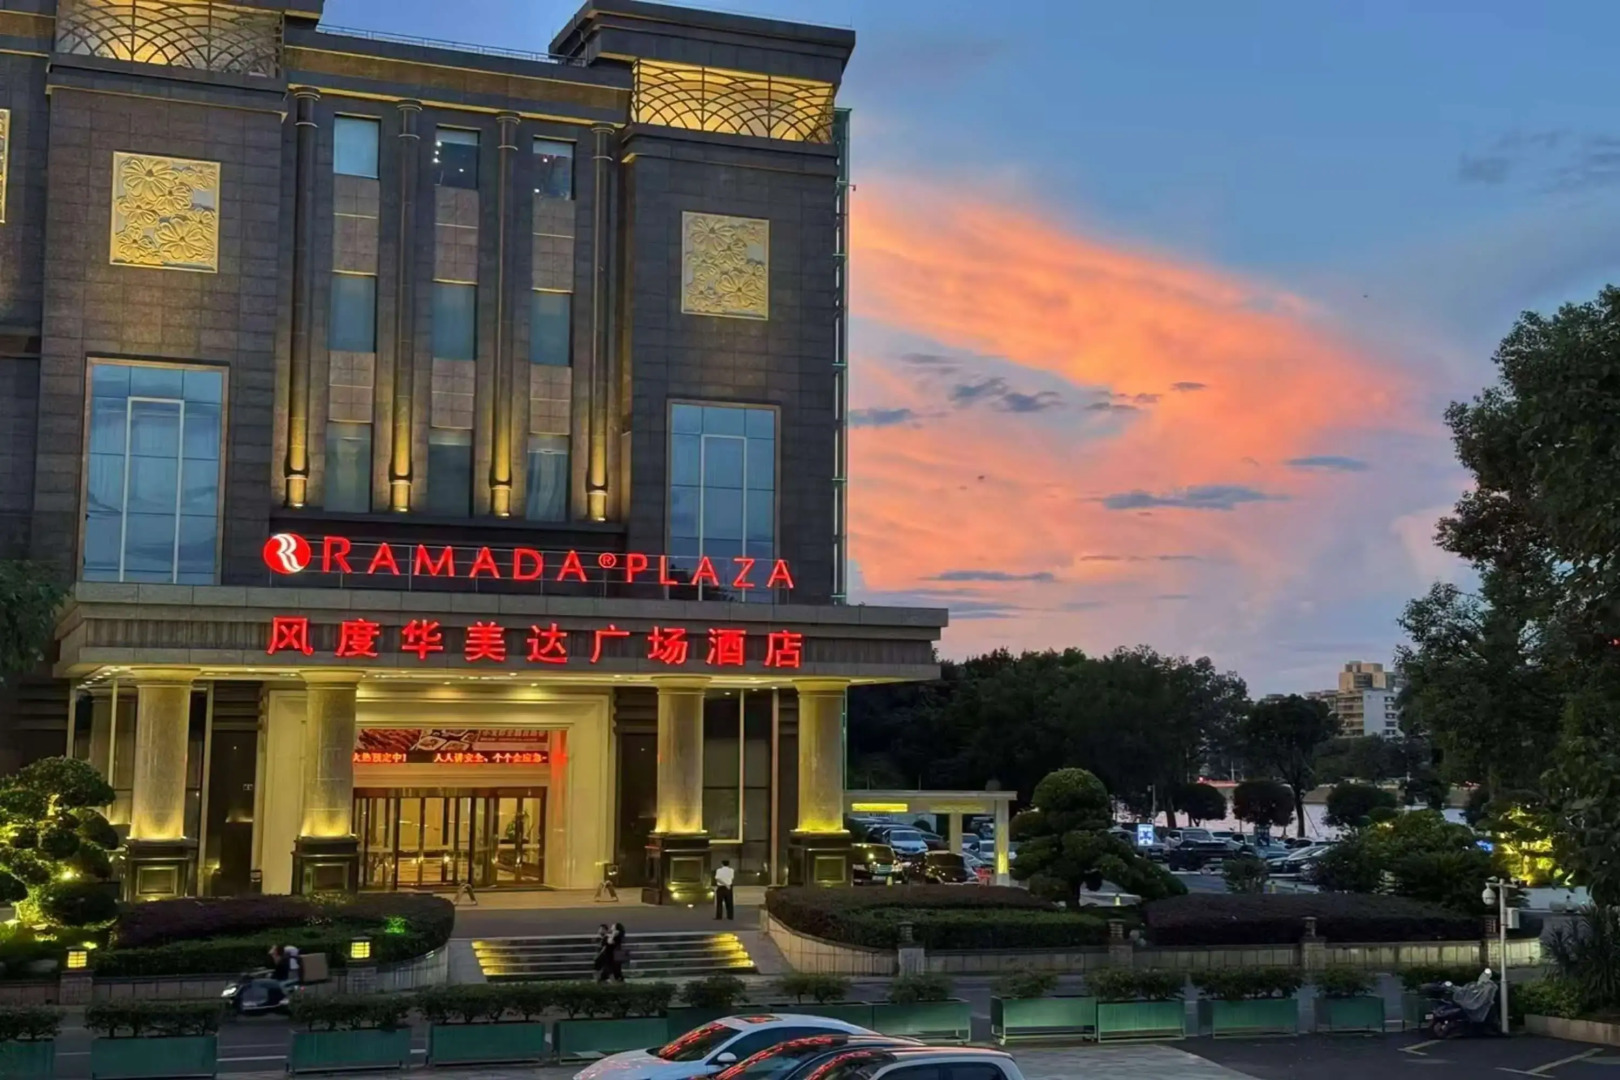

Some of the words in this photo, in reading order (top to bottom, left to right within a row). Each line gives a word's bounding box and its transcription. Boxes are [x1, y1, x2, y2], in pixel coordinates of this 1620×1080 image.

[625, 552, 794, 589] PLAZA
[266, 615, 804, 669] 风度华美达广场酒店
